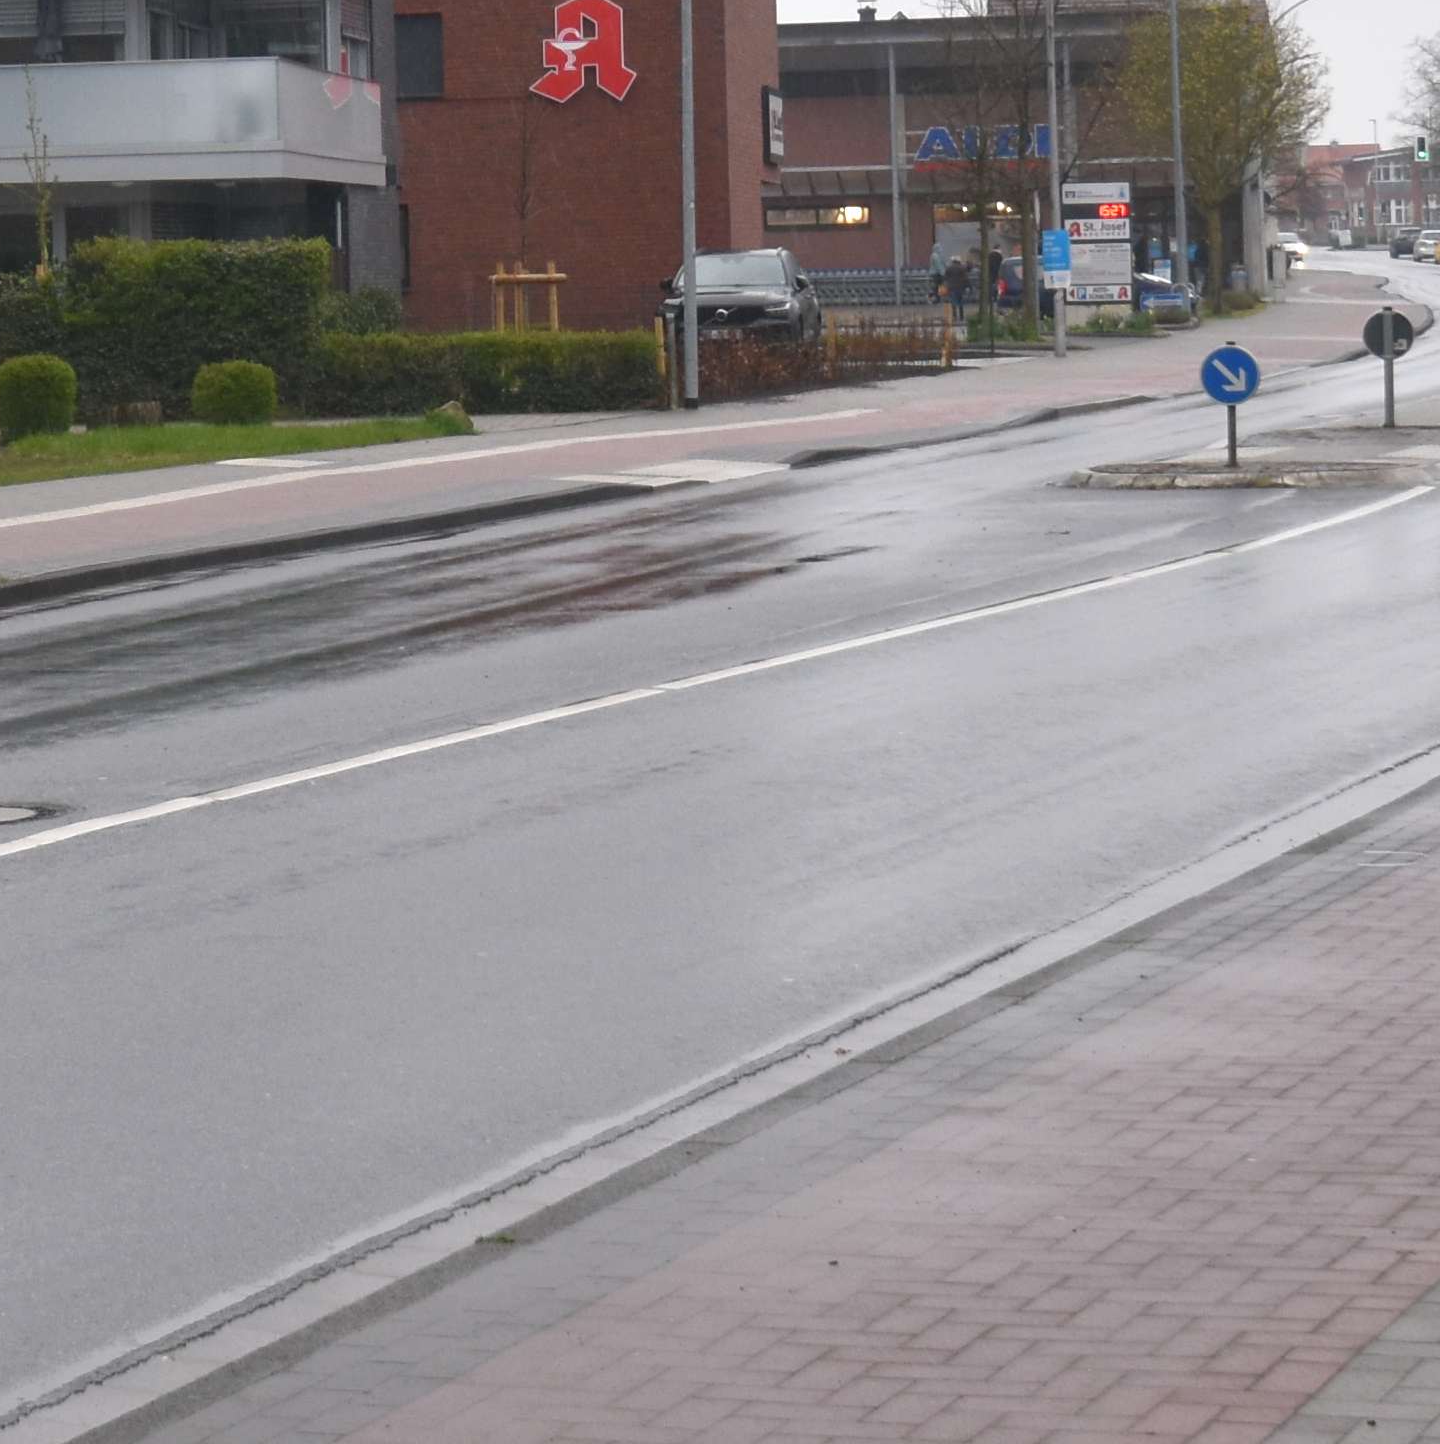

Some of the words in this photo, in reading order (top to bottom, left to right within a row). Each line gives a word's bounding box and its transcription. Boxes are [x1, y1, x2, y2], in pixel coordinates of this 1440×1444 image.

[914, 124, 1051, 161] ALDI
[1083, 221, 1097, 231] St.
[1100, 220, 1126, 231] Josef
